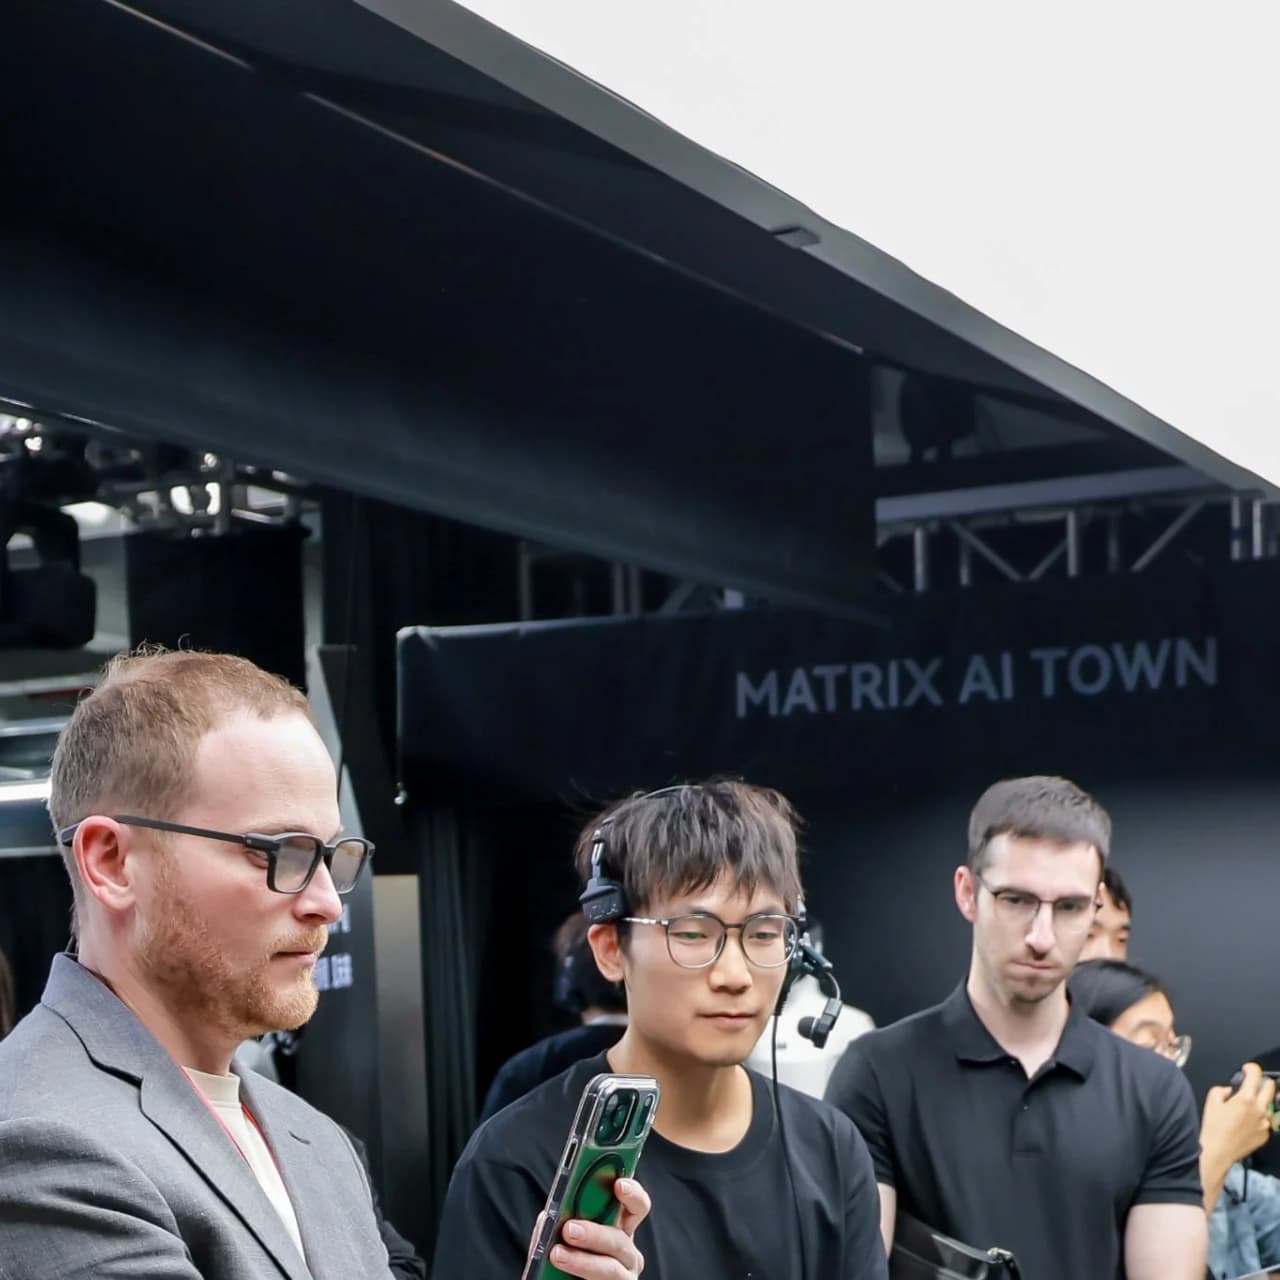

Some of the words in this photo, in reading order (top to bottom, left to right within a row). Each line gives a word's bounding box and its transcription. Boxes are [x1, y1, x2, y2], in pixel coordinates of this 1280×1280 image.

[734, 657, 944, 718] MATRIX
[958, 651, 1014, 703] AI
[1029, 635, 1219, 698] TOWN
